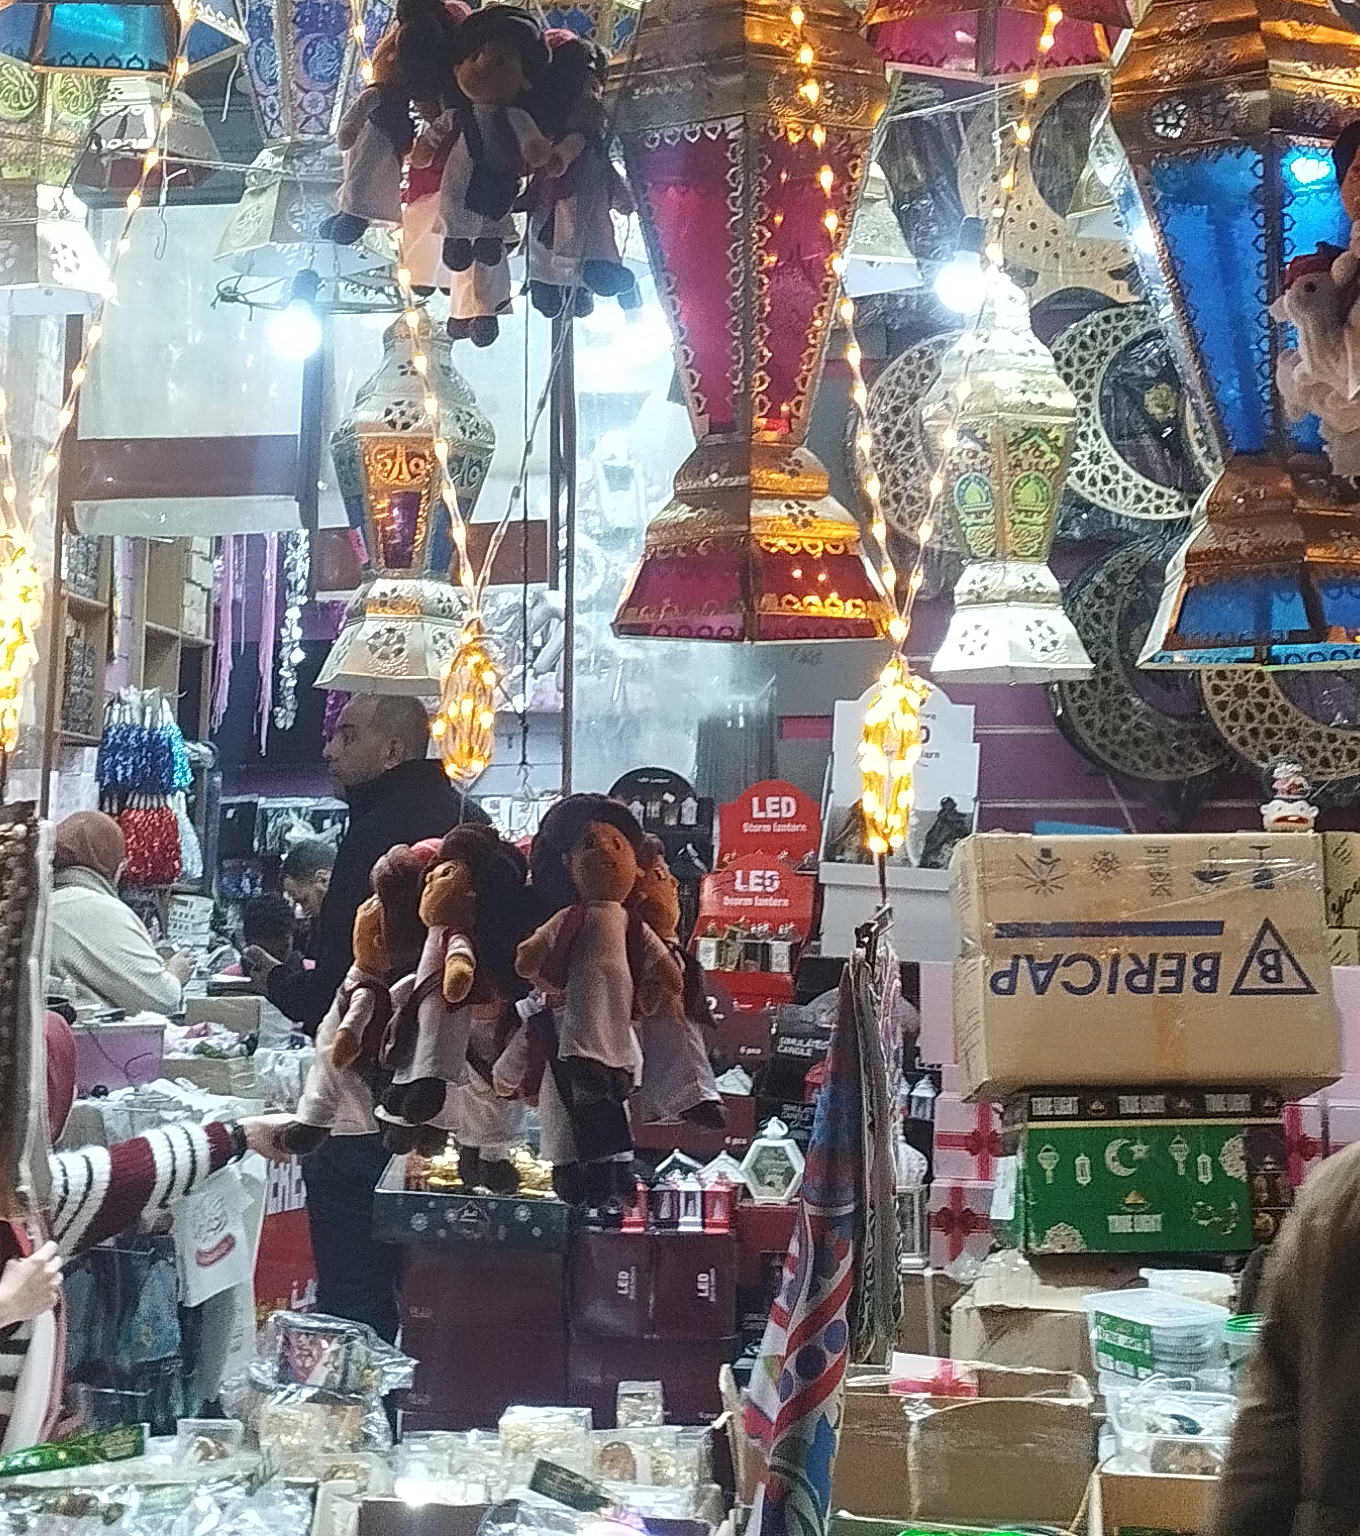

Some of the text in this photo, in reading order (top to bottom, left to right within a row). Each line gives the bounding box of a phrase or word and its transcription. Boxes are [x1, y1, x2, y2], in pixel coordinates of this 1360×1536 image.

[751, 796, 797, 819] LED
[734, 870, 781, 893] LED
[989, 949, 1283, 997] B BERICAP
[617, 1270, 630, 1295] LED
[697, 1272, 710, 1298] LED
